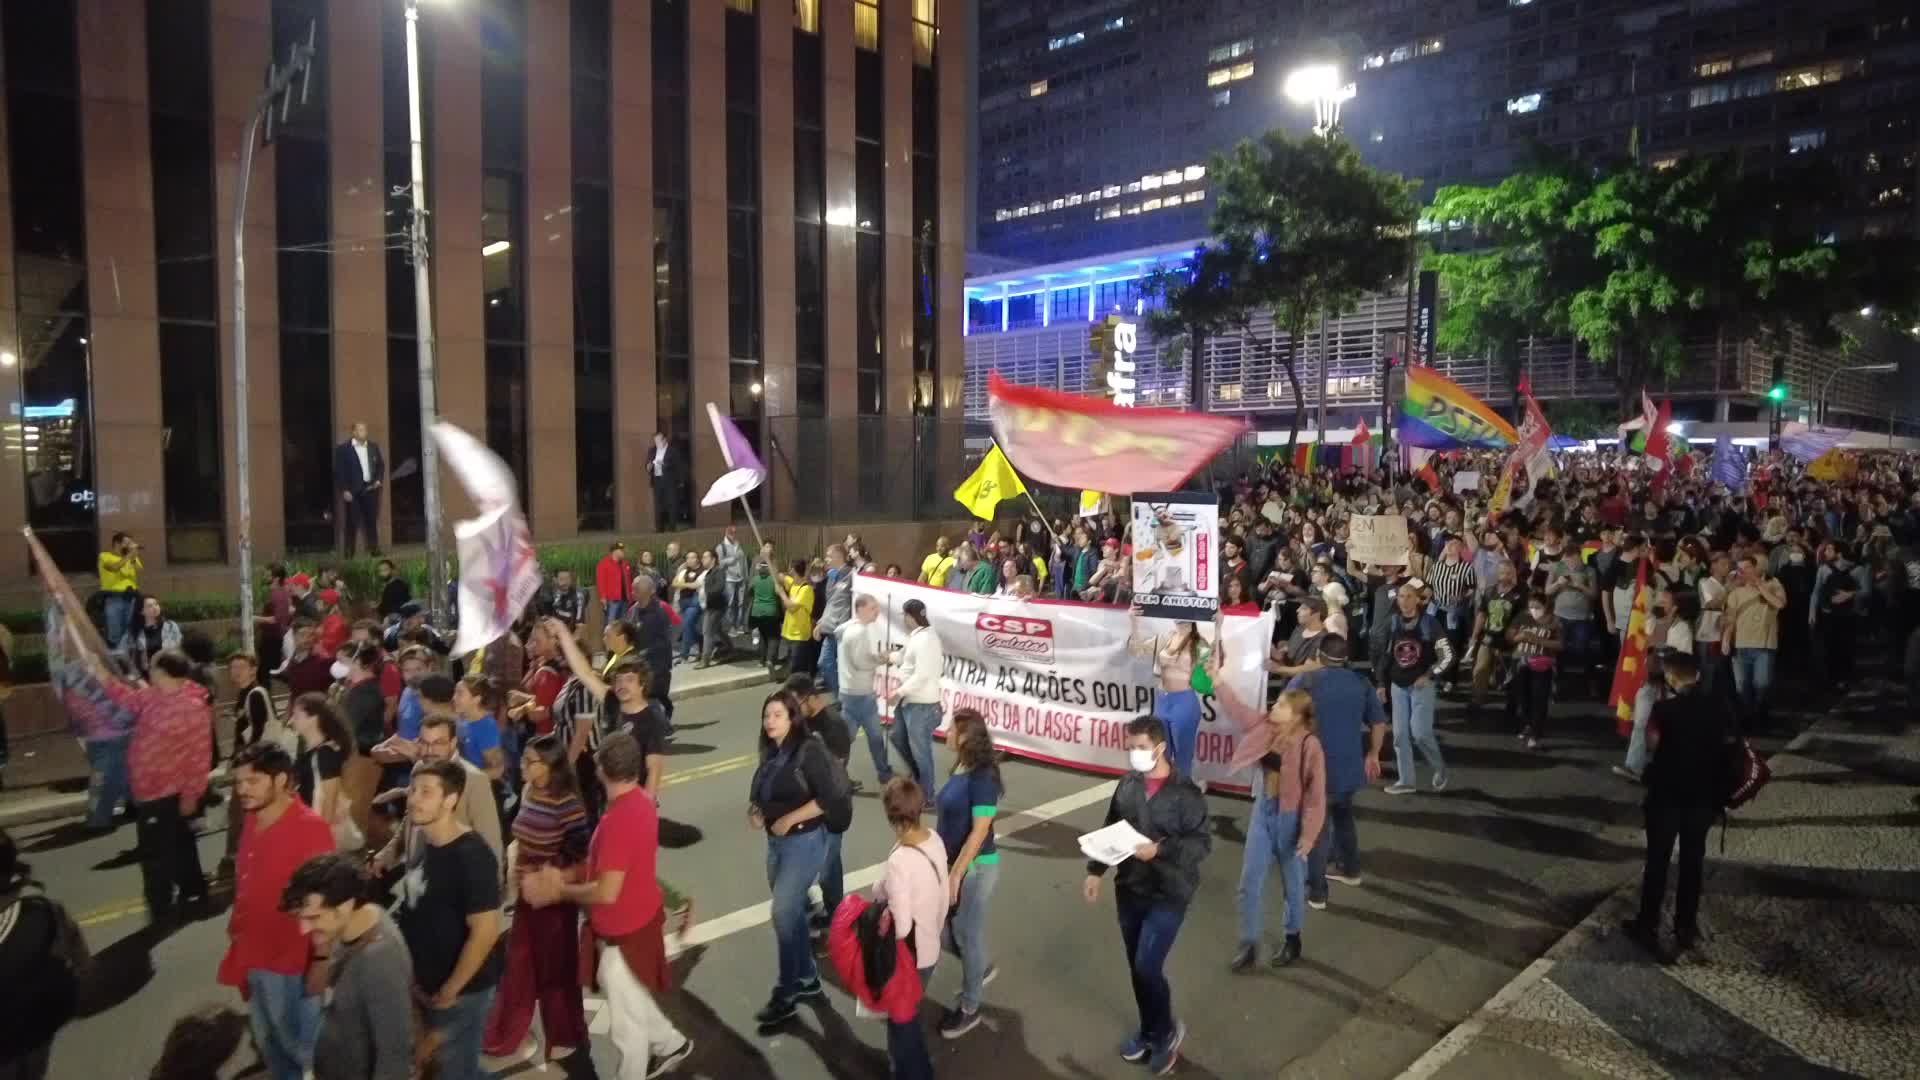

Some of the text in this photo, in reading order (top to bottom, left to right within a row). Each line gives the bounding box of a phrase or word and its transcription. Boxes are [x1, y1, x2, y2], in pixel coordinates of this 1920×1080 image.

[1134, 593, 1160, 605] SEM
[980, 616, 1047, 635] CSP
[995, 665, 1018, 693] AS
[1023, 670, 1087, 705] AÇÕES
[1003, 702, 1020, 732] DA
[1025, 706, 1084, 744] CLASSE
